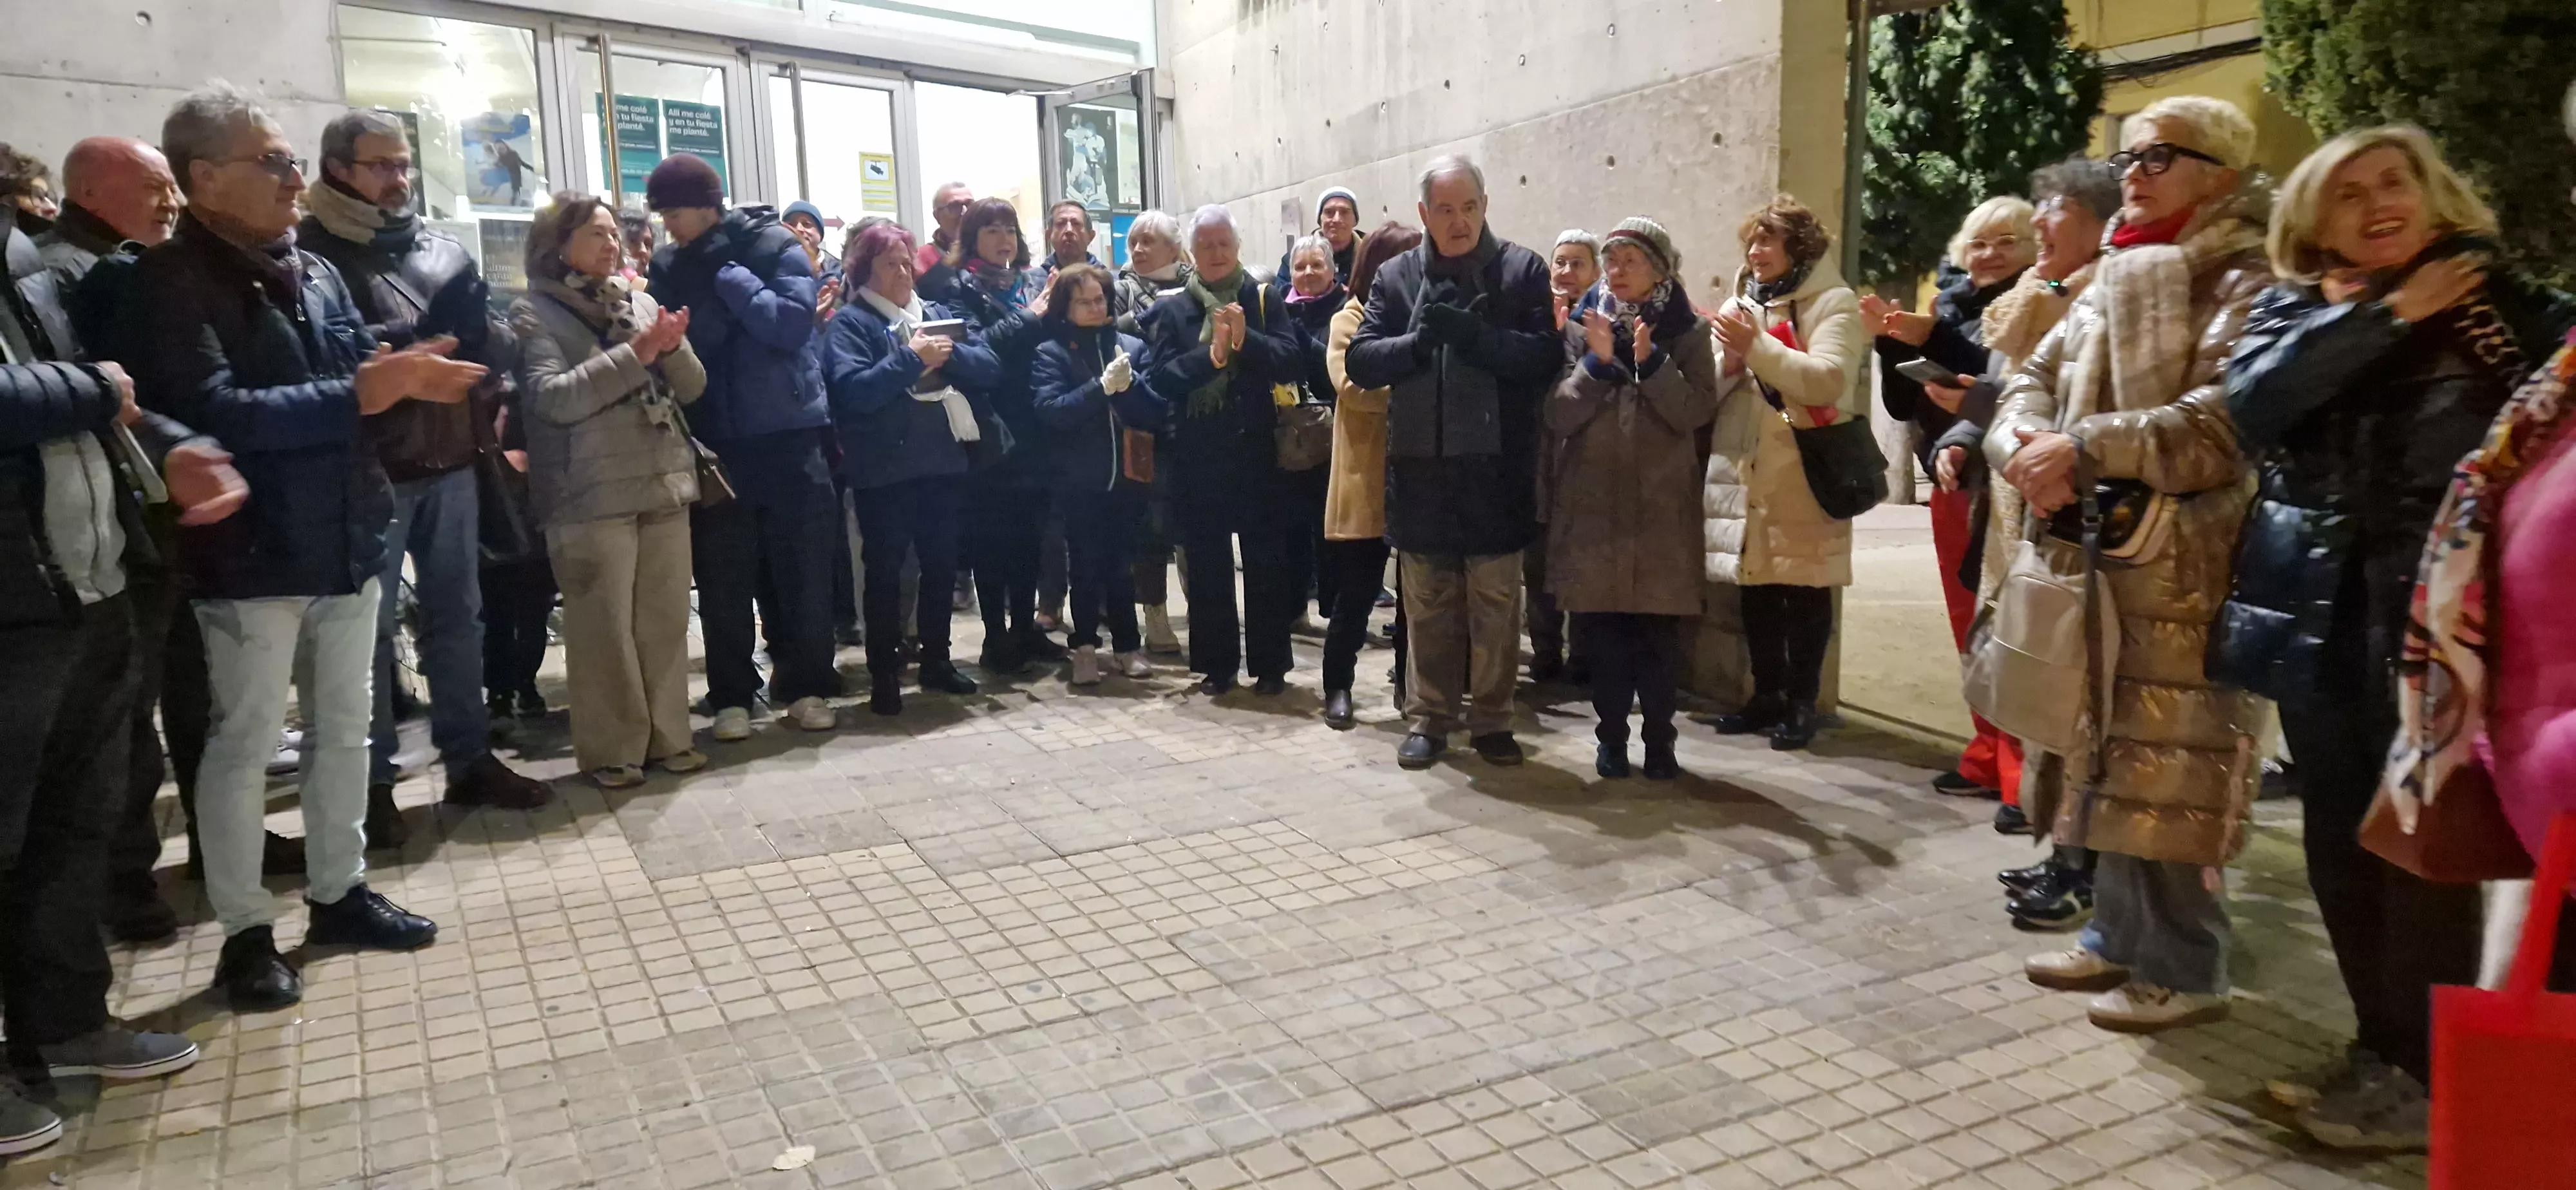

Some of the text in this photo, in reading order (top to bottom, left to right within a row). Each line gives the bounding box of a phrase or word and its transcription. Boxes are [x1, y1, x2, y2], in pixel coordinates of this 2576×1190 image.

[630, 106, 647, 114] colé
[621, 113, 630, 121] tu
[631, 113, 654, 123] fiesta
[696, 111, 711, 120] colé
[696, 118, 718, 129] fiesta
